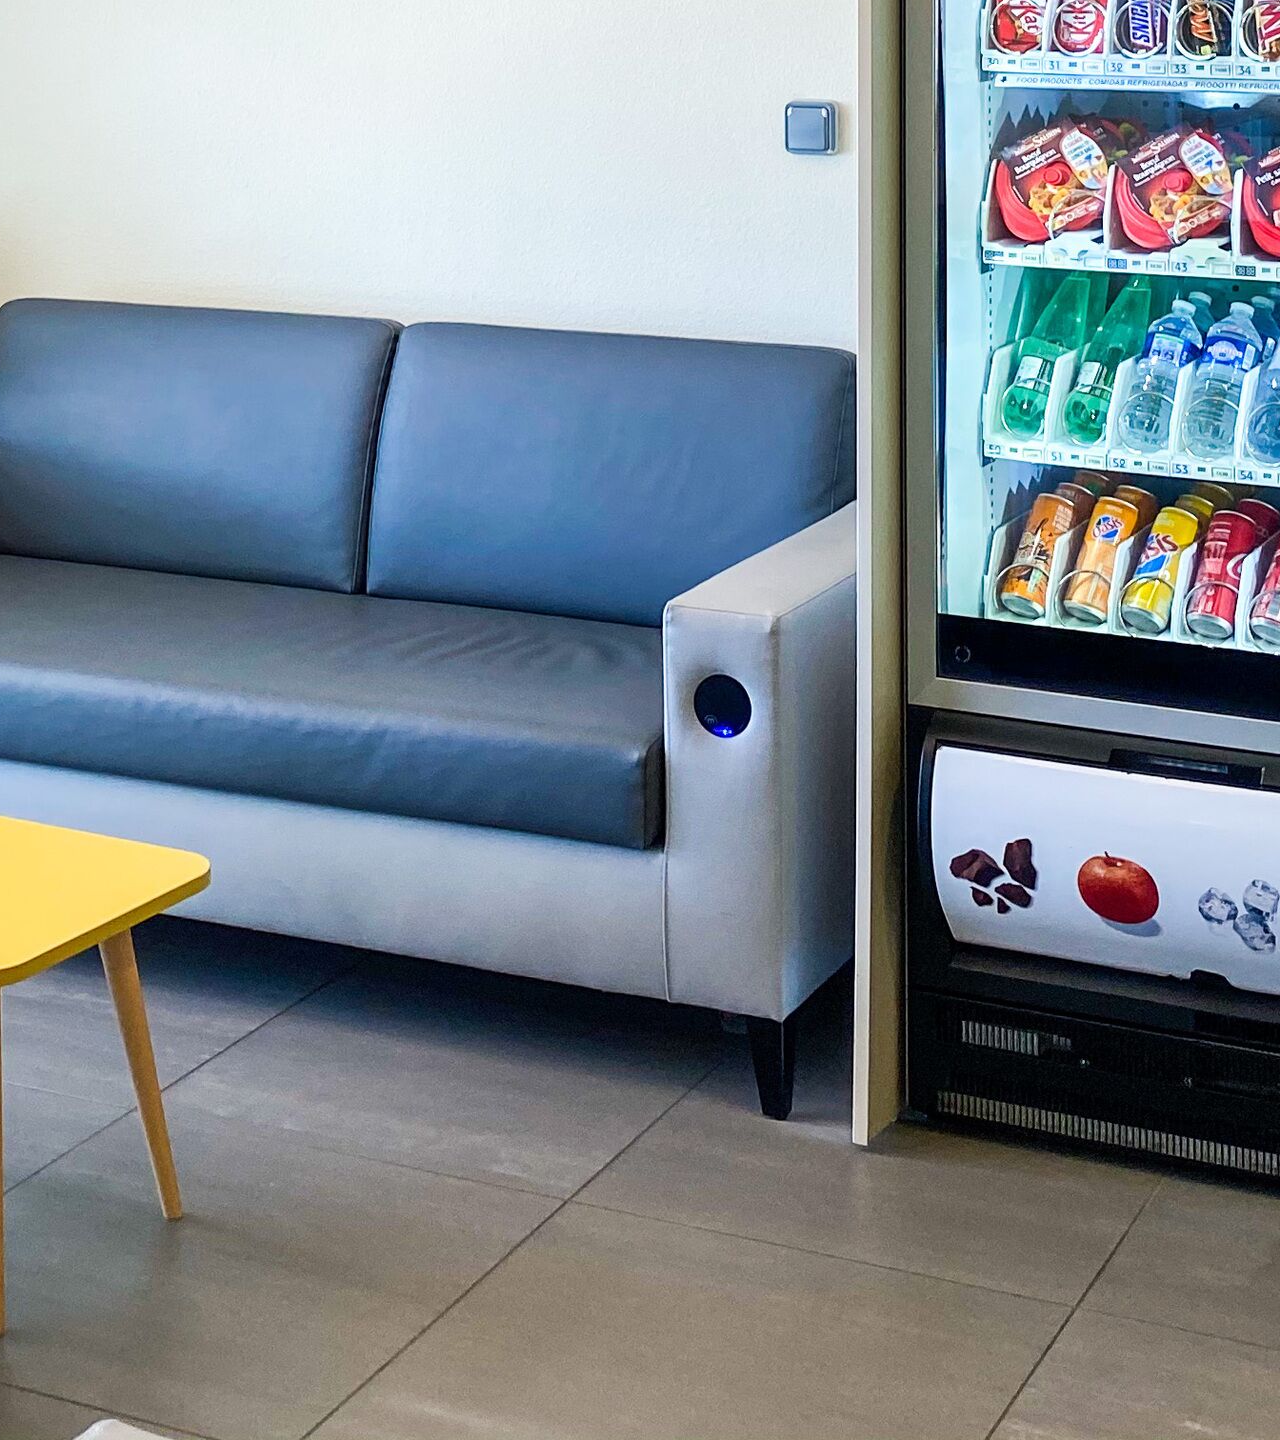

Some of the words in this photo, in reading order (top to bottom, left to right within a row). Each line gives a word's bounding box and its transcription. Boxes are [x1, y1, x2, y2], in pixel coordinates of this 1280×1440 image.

[1049, 61, 1060, 70] 31
[1110, 63, 1123, 72] 32
[1173, 64, 1187, 73] 33
[1238, 66, 1251, 75] 34
[1040, 77, 1082, 85] PRODUCTS
[1174, 262, 1188, 272] 43
[1051, 452, 1062, 461] 51
[1112, 459, 1126, 468] 52
[1175, 464, 1189, 474] 53
[1240, 471, 1253, 480] 54
[1092, 517, 1124, 538] Oasis
